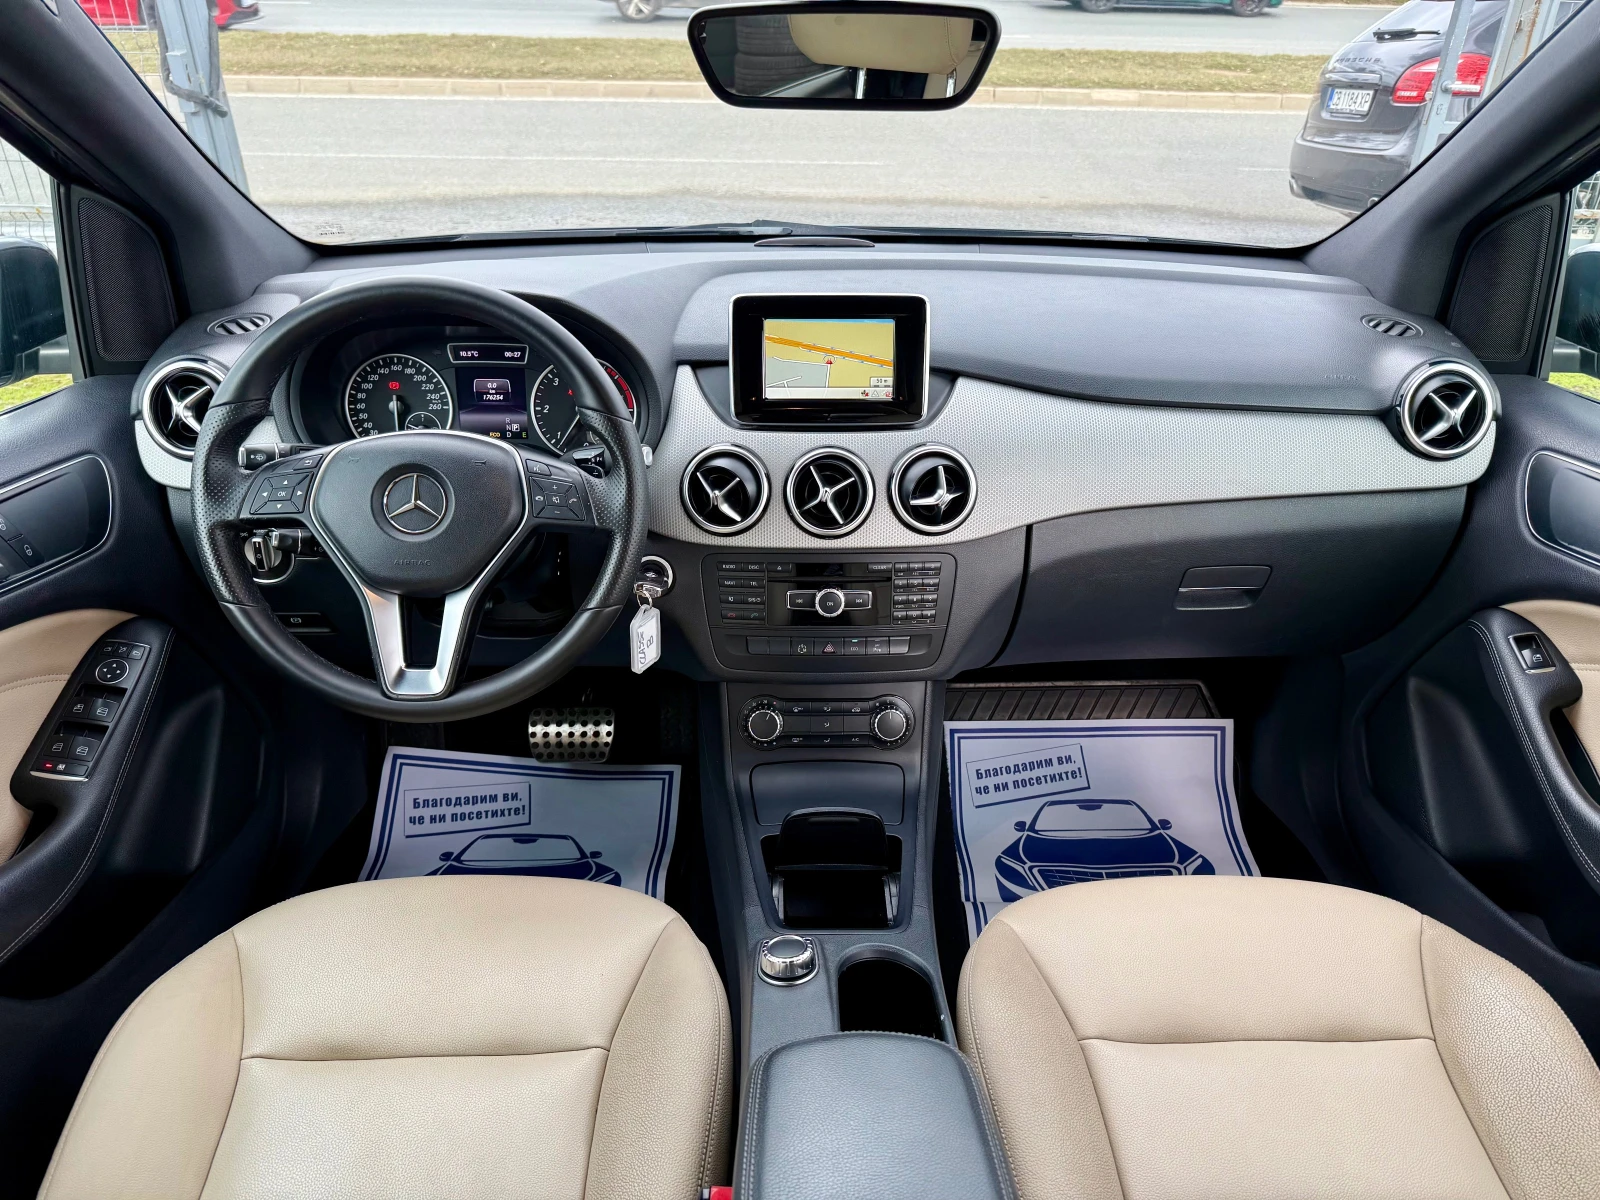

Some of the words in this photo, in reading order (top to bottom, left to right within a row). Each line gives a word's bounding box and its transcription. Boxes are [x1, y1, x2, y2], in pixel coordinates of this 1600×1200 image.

[975, 758, 1054, 780] Благодарим
[1057, 754, 1076, 765] ви,
[975, 785, 990, 795] че
[993, 782, 1009, 793] ни
[1012, 767, 1082, 789] посетихте!
[413, 793, 498, 809] Благодарим
[409, 815, 424, 825] че
[430, 814, 446, 824] ни
[451, 805, 526, 822] посетихте!
